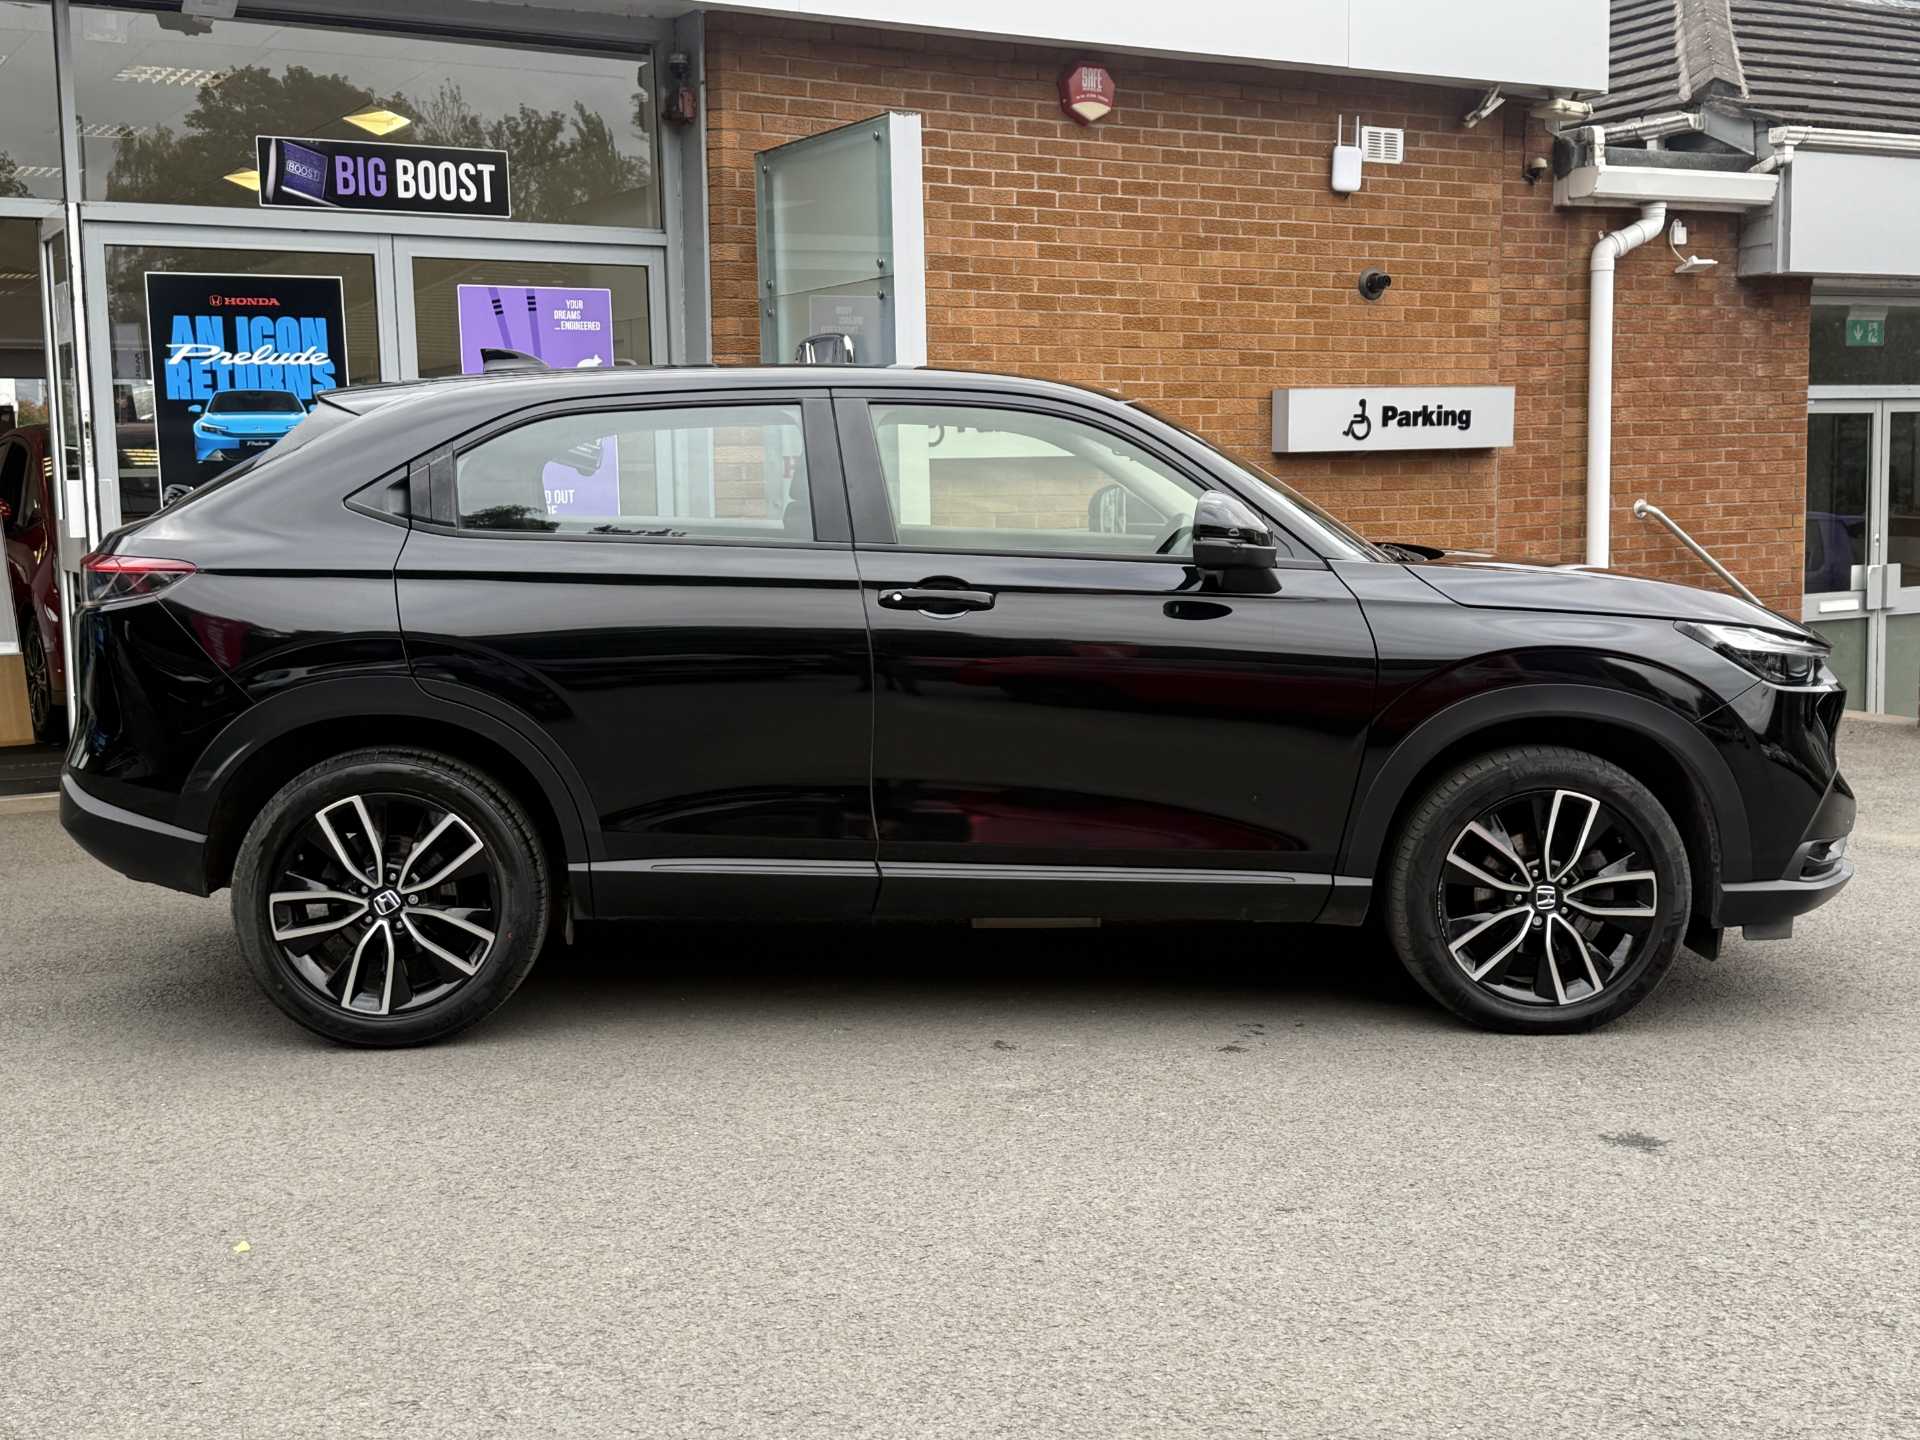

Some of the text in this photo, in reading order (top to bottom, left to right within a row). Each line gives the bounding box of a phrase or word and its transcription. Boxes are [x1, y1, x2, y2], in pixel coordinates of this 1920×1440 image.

[335, 155, 496, 203] BIG BOOST
[224, 297, 281, 306] HONDA
[566, 299, 583, 309] YOUR
[554, 310, 581, 320] DREAMS
[171, 315, 329, 358] AN ICON
[166, 344, 332, 366] Prelude
[164, 358, 337, 400] RETURNS
[1381, 405, 1472, 430] Parking
[554, 489, 575, 504] OUT
